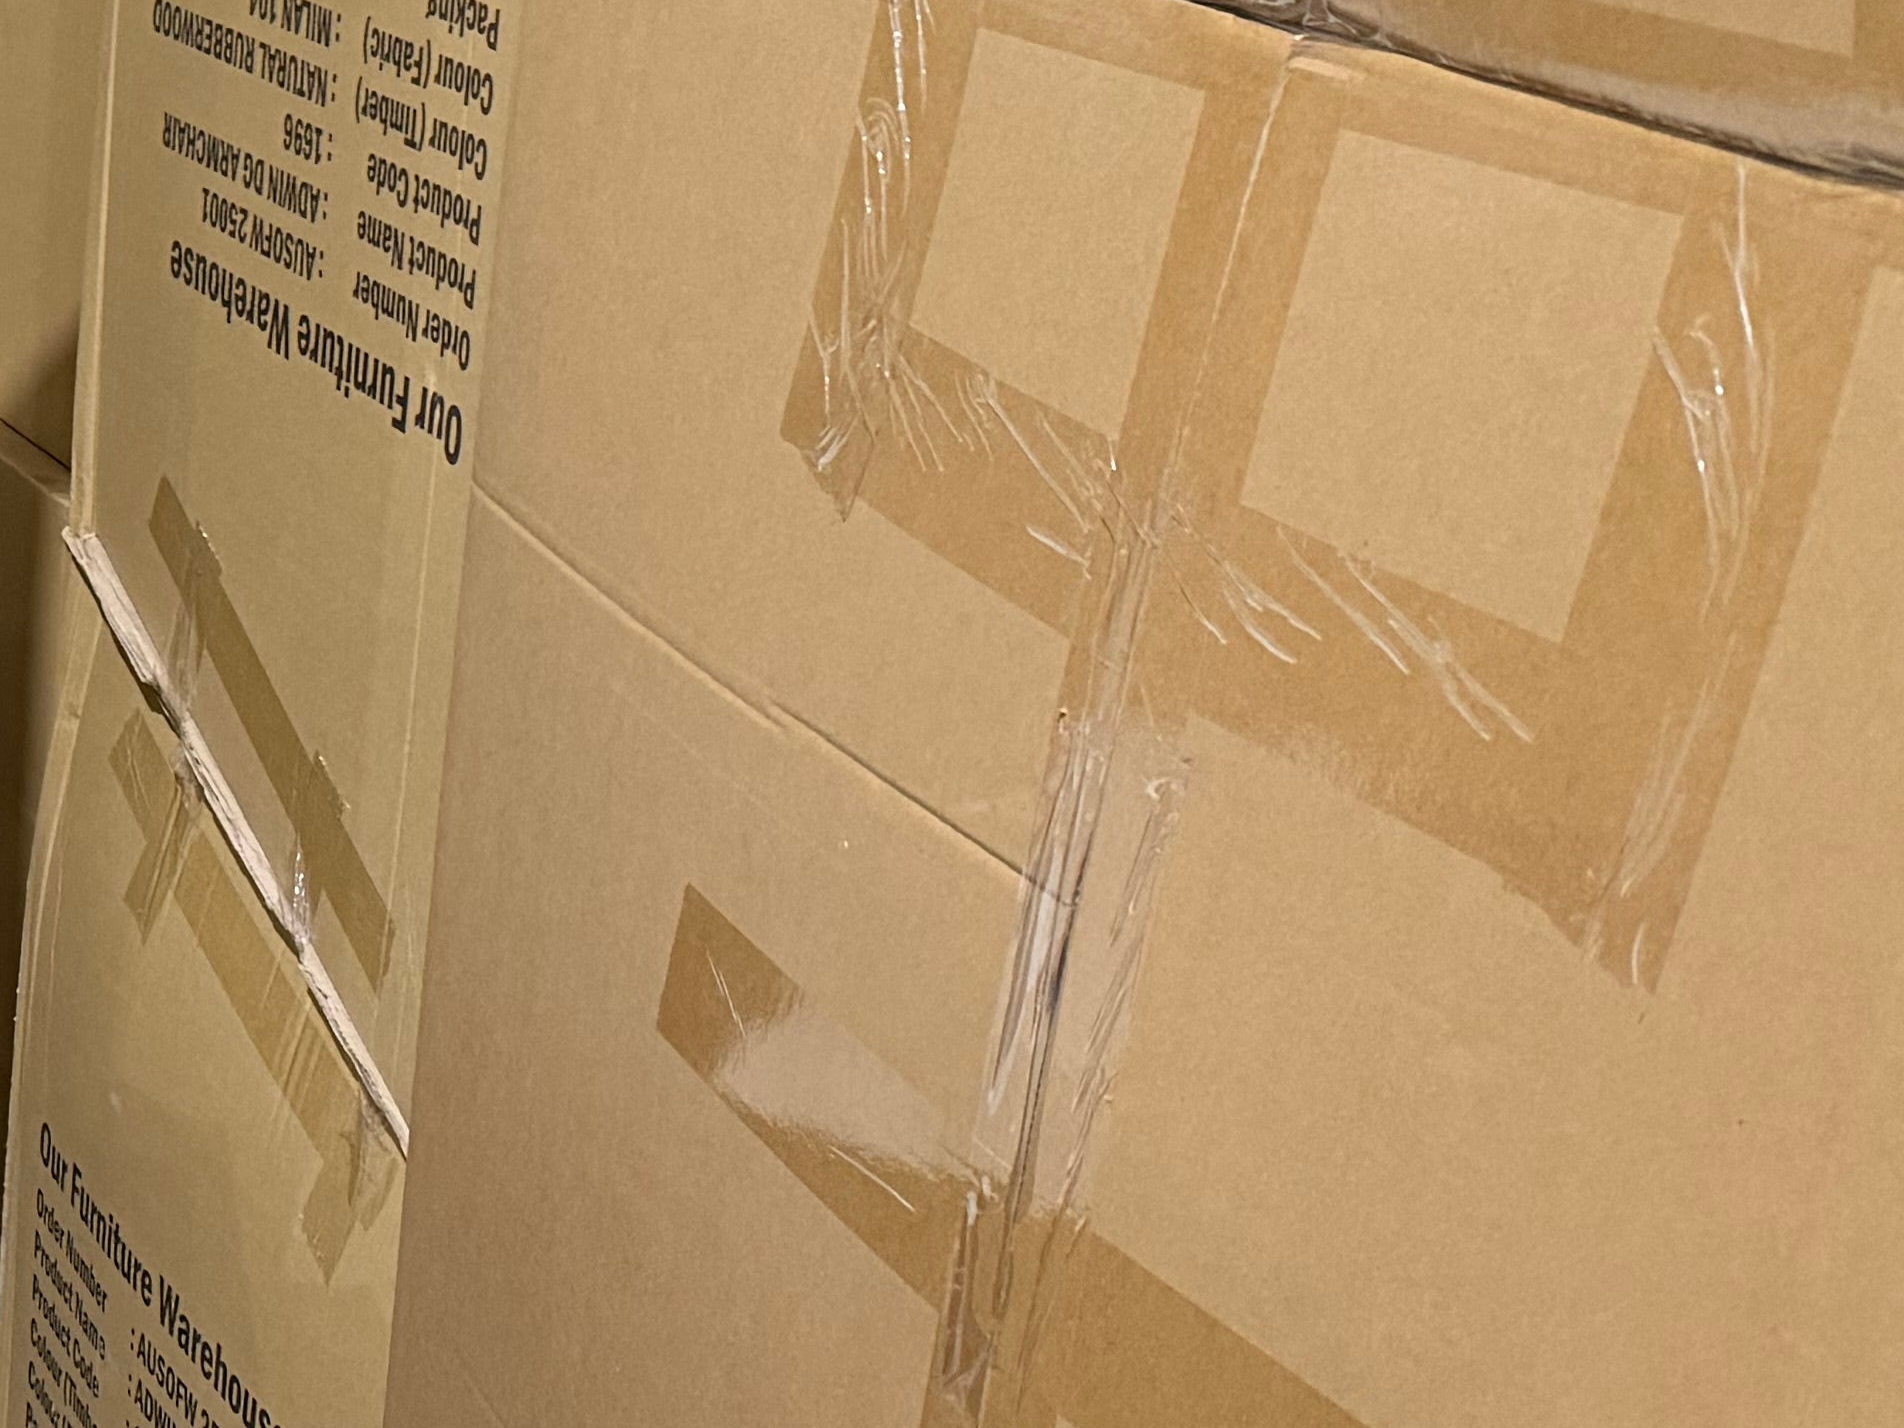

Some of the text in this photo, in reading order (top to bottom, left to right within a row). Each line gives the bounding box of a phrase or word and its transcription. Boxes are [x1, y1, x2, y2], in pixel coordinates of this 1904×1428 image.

[170, 240, 462, 465] Our Furniture Warehouse
[40, 1124, 68, 1192] Our
[71, 1162, 152, 1307] Furniture
[137, 1332, 198, 1427] AUSOFW
